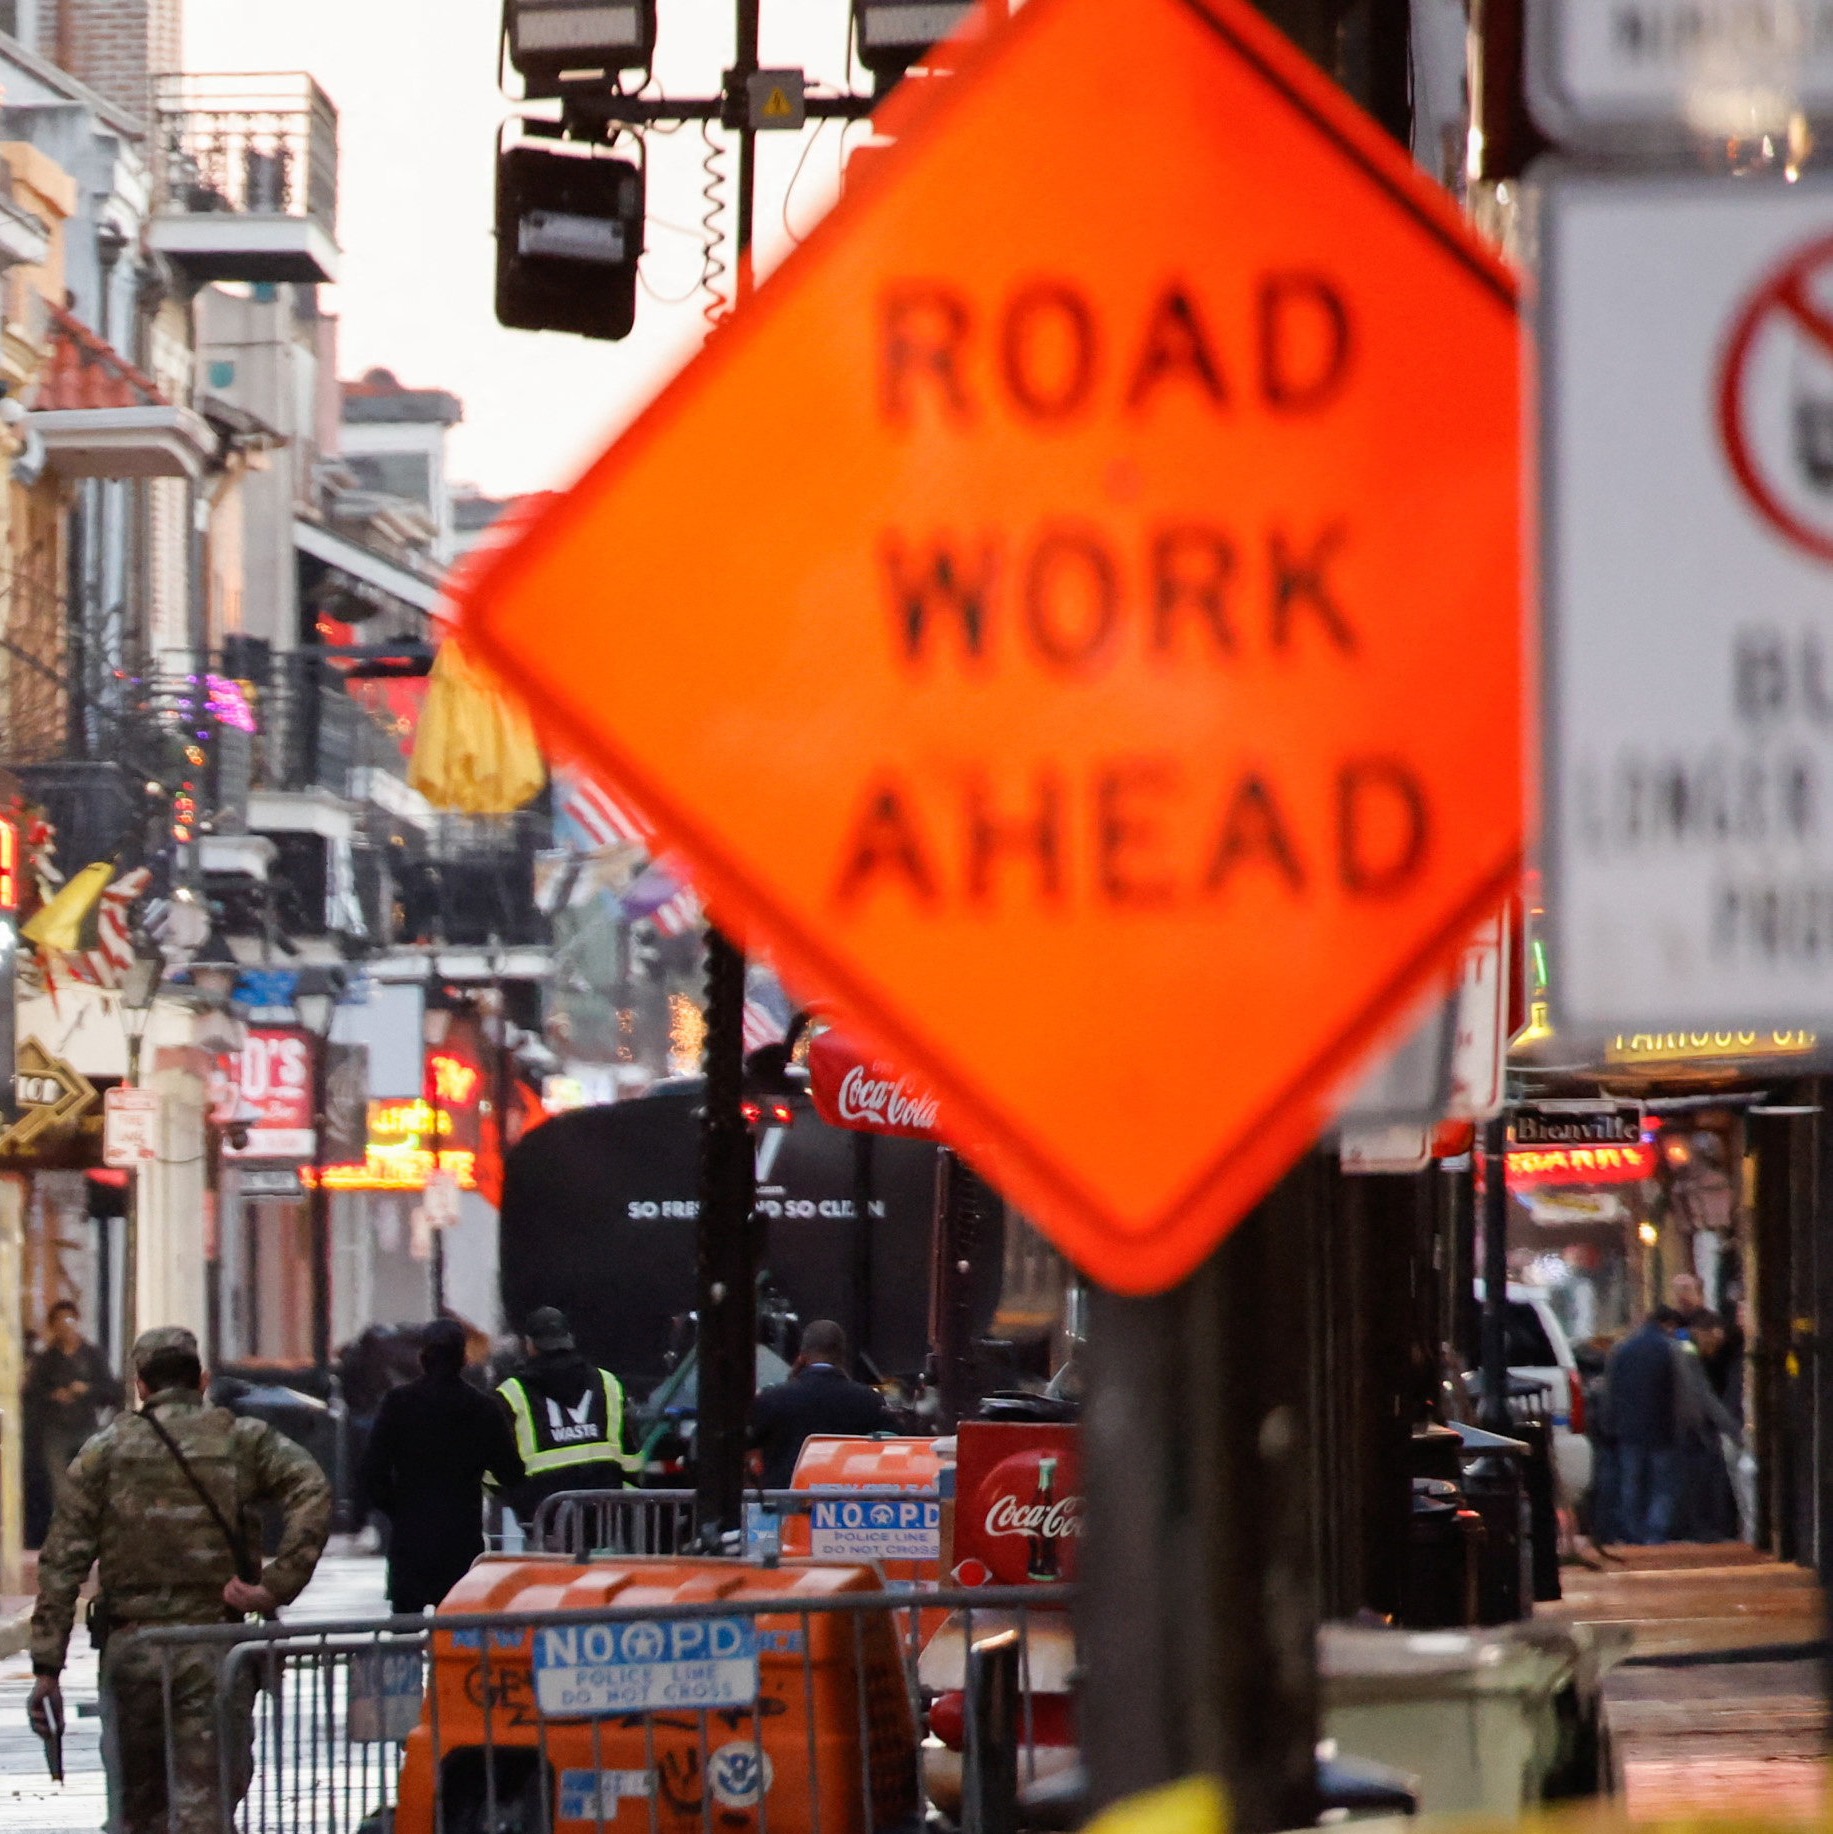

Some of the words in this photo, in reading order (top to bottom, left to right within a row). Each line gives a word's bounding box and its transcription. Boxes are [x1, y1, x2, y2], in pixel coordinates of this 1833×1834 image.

[881, 270, 1351, 430] ROAD
[881, 520, 1361, 668] WORK
[838, 753, 1431, 905] AHEAD
[628, 1201, 658, 1219] SO
[784, 1200, 816, 1219] SO
[550, 1423, 598, 1442] WASTE
[833, 1531, 889, 1542] POLICE
[894, 1531, 928, 1541] LINE
[822, 1545, 845, 1555] DO
[850, 1545, 880, 1555] NOT
[886, 1545, 940, 1555] CROSS
[575, 1668, 654, 1686] POLICE
[671, 1666, 715, 1683] LINE
[561, 1688, 592, 1705] DO
[663, 1681, 733, 1700] CROSS
